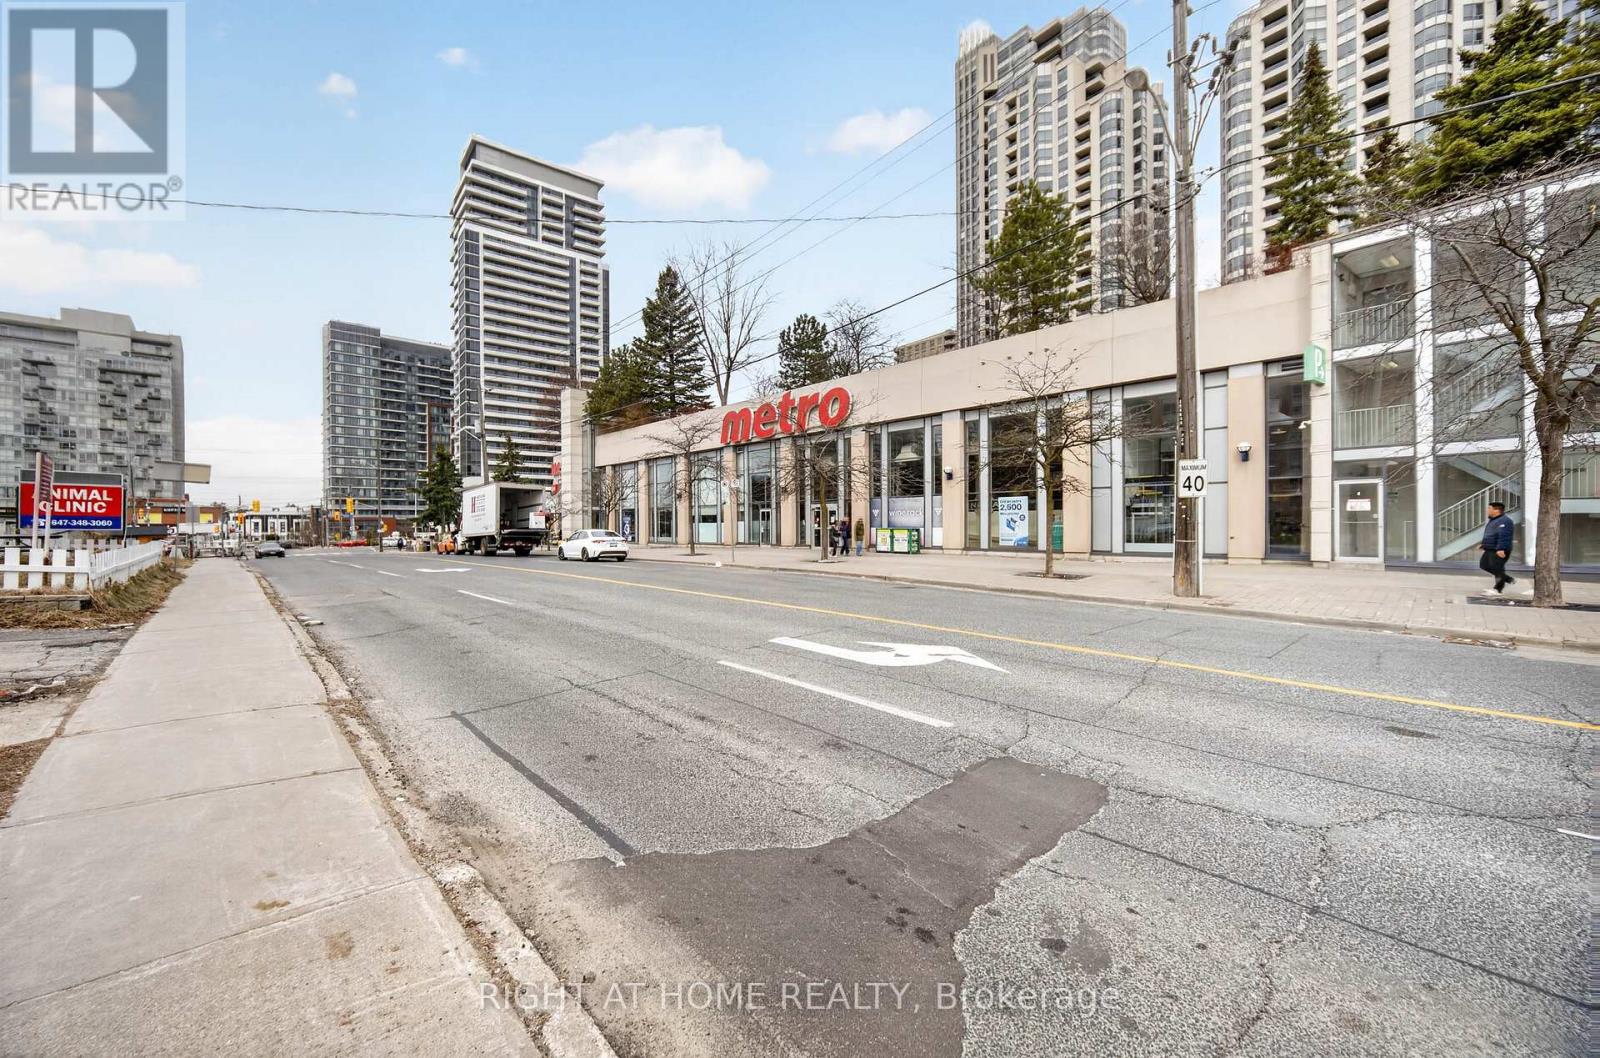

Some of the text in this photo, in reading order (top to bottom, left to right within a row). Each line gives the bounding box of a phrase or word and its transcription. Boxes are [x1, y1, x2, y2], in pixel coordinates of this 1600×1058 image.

[720, 387, 851, 444] metro
[1183, 475, 1204, 492] 40
[33, 488, 112, 500] NIMAL
[39, 501, 106, 513] CLINIC
[52, 519, 112, 527] 647-348-3060
